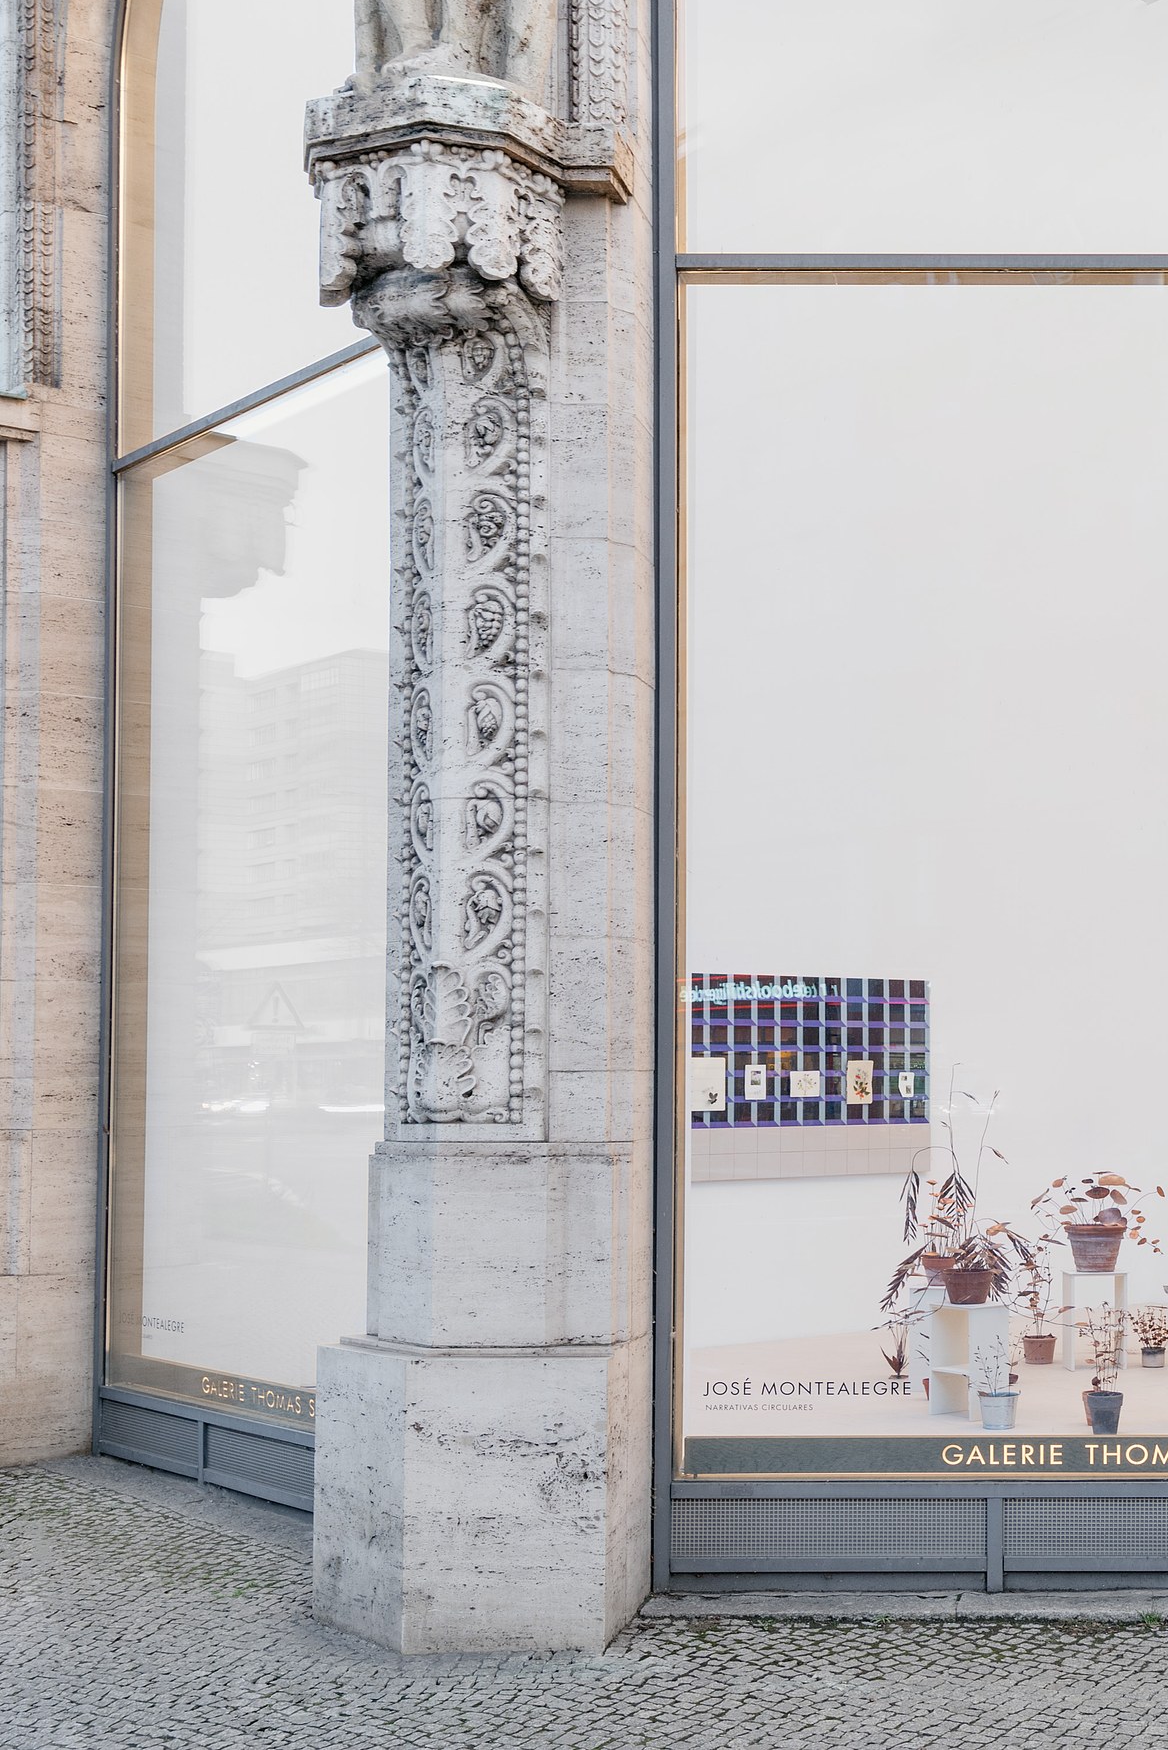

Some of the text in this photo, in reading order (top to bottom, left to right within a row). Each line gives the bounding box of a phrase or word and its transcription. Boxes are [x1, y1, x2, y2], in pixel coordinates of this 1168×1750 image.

[201, 1376, 245, 1402] GALERIE
[251, 1386, 302, 1414] THOMAS
[703, 1378, 912, 1397] JOSÉ MONTEALEGRE
[705, 1403, 814, 1411] NARRATIVAS CIRCULARES
[941, 1444, 1063, 1466] GALERIE
